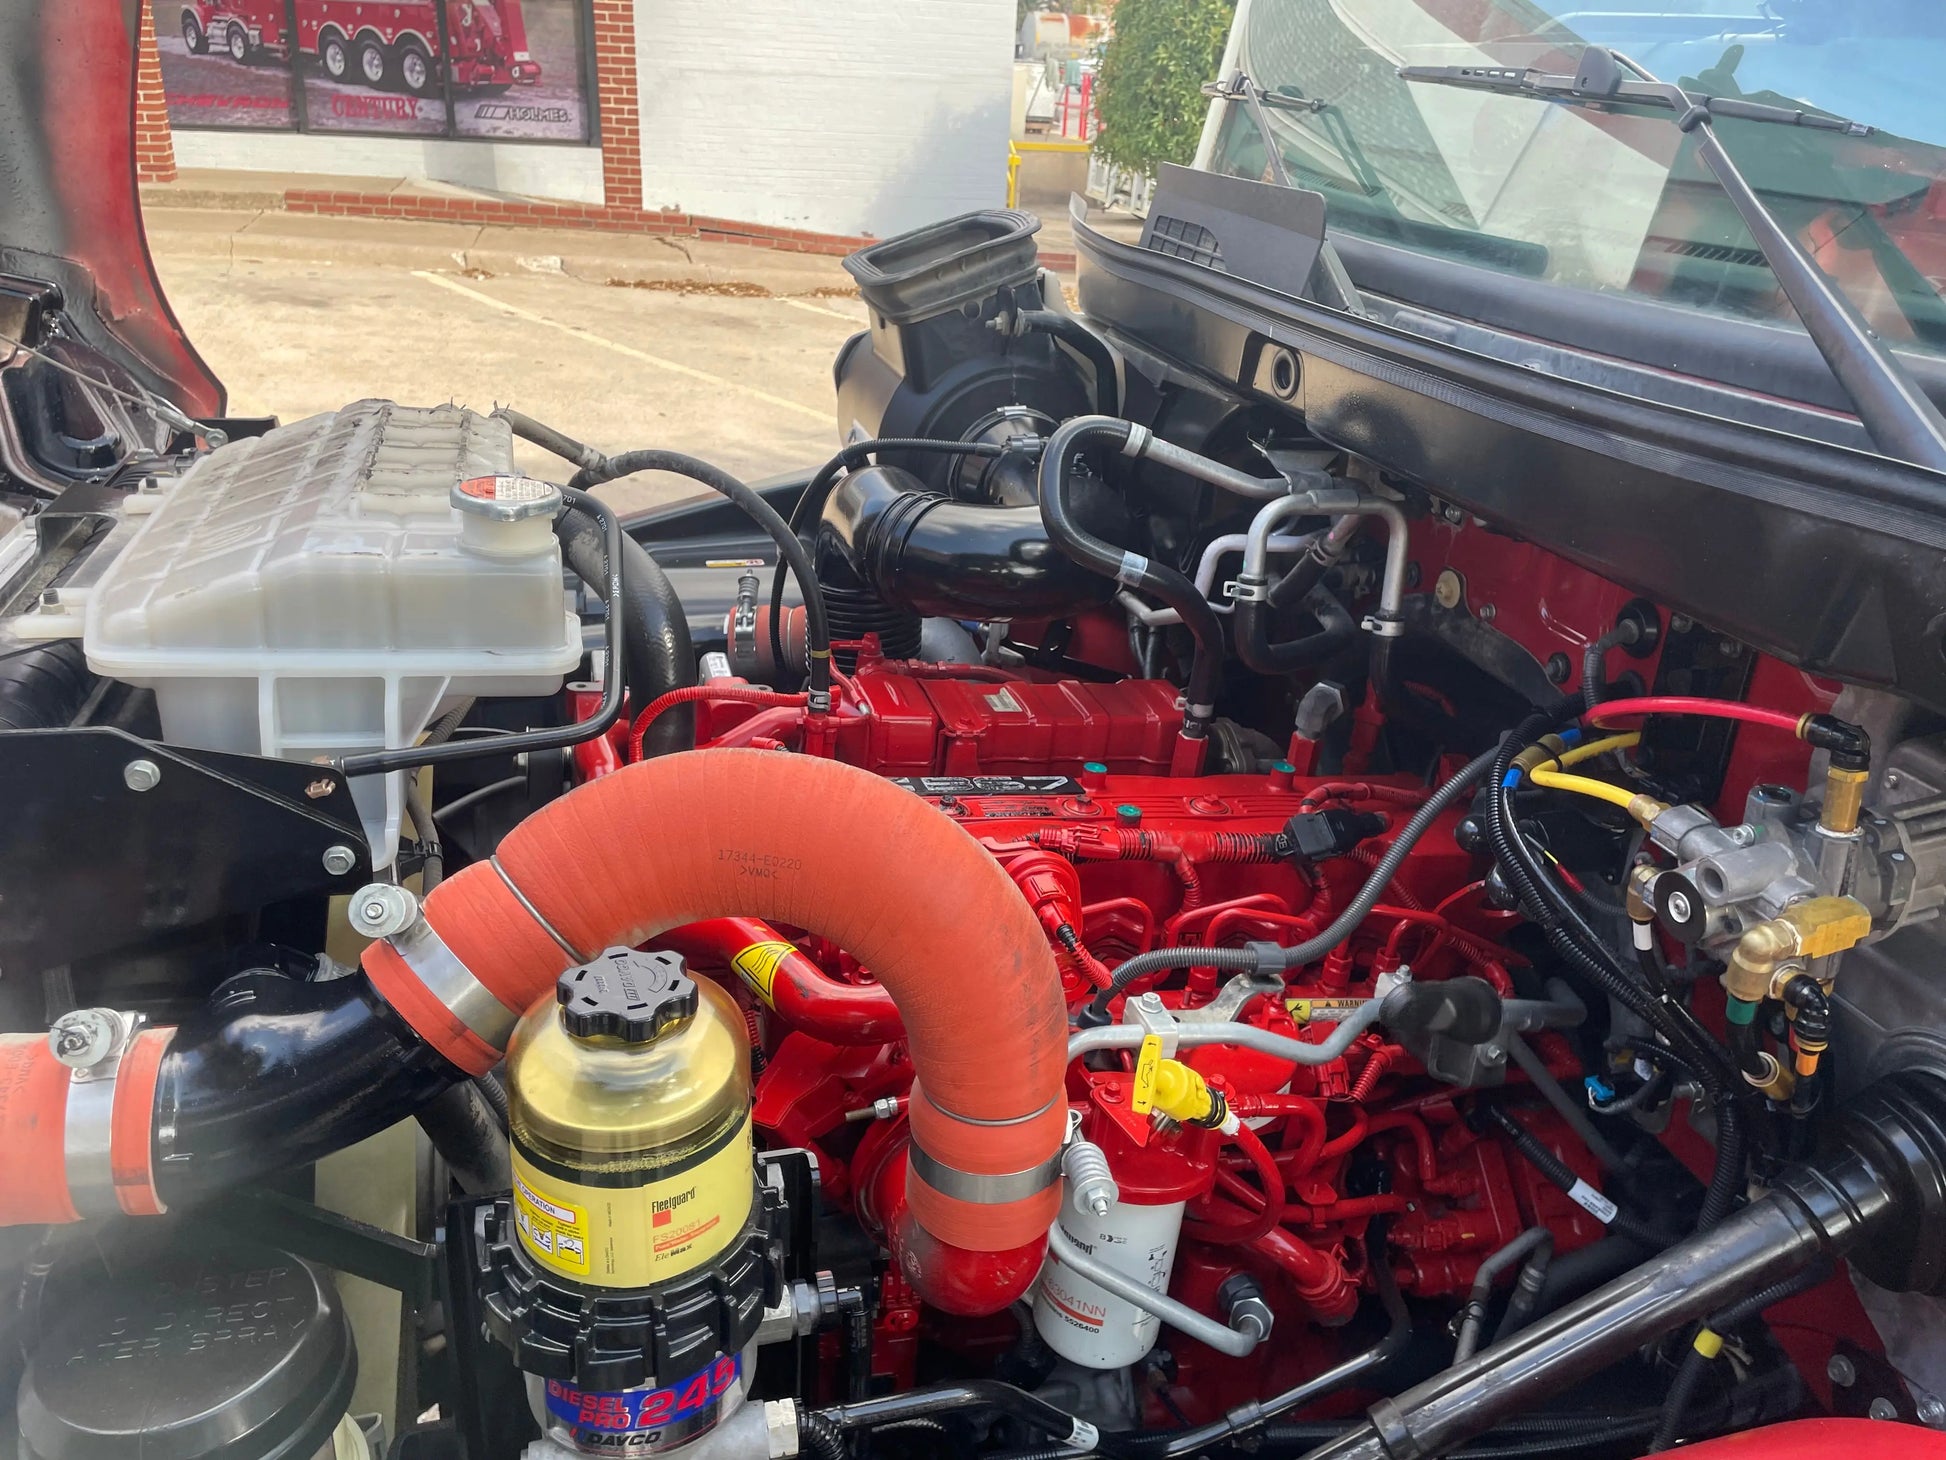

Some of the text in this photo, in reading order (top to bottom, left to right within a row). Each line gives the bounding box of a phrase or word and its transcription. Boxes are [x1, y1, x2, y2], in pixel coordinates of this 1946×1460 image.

[331, 94, 418, 120] CENTURY
[506, 105, 568, 122] HOLMES
[520, 1185, 556, 1215] OPERATION
[651, 1186, 696, 1213] Fleetguard
[1064, 1316, 1100, 1334] 5526400
[548, 1354, 736, 1429] DIESEL 245
[578, 1409, 631, 1430] PRO
[586, 1431, 662, 1447] DAVCO
